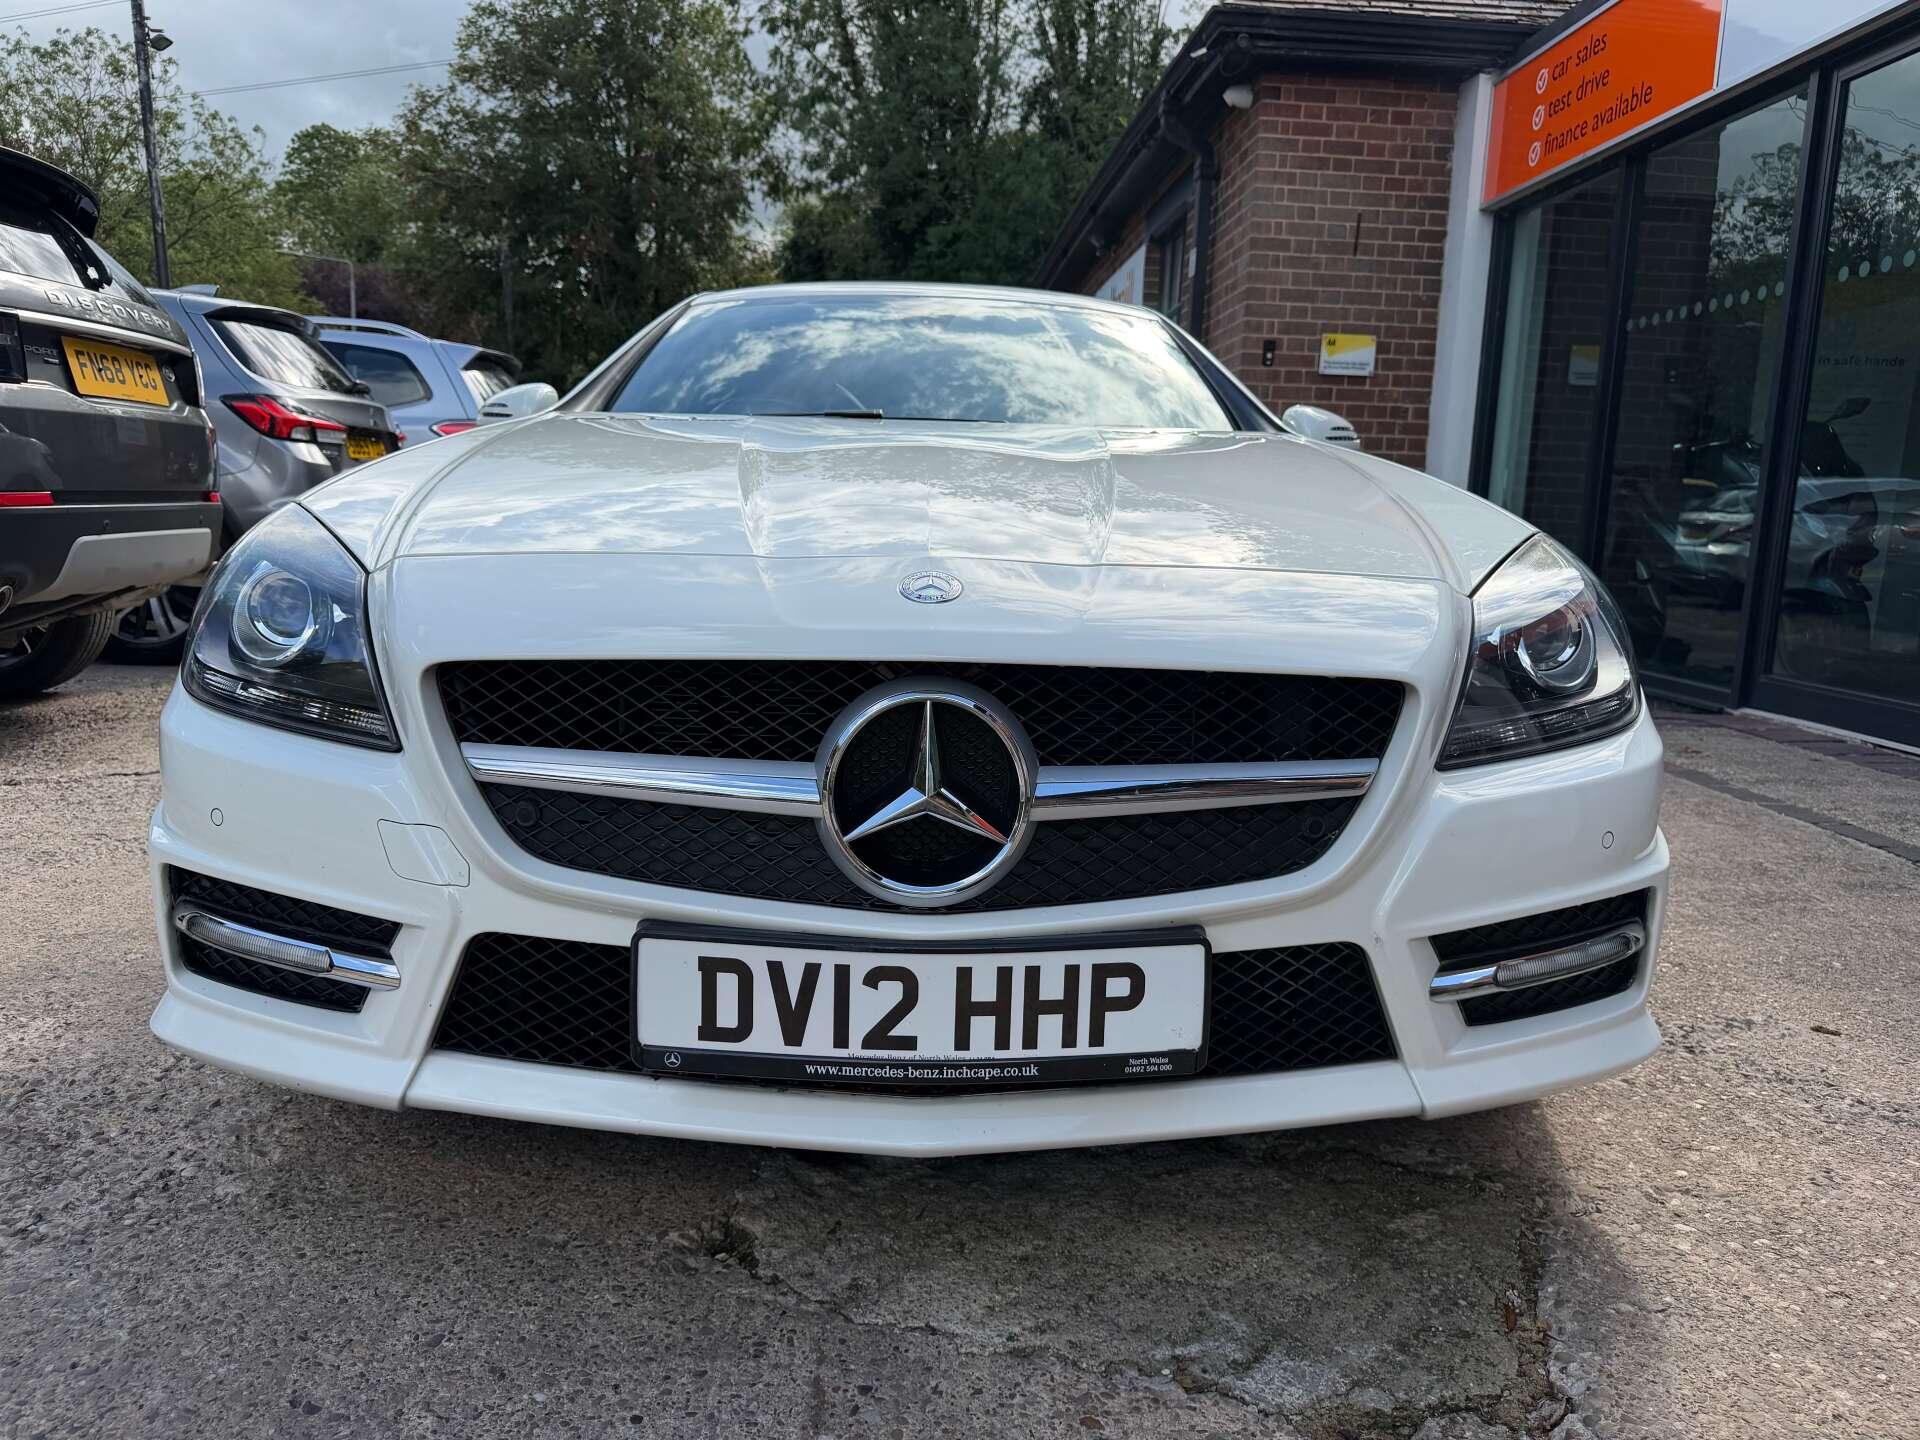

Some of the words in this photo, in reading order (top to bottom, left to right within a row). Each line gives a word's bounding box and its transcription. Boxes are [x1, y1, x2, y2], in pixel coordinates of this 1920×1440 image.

[1551, 56, 1572, 81] car
[1575, 33, 1608, 67] sales
[1548, 91, 1572, 118] test
[1576, 69, 1610, 101] drive
[1543, 120, 1588, 156] finance
[1592, 81, 1653, 132] available
[44, 289, 172, 330] DISCOVERY
[697, 955, 920, 1051] DV12
[953, 961, 1146, 1052] HHP
[805, 1063, 1040, 1080] www.mercedes-benz.inchcape.co.uk
[1124, 1066, 1144, 1074] 01492
[1129, 1057, 1148, 1066] North
[1150, 1056, 1169, 1065] Wales
